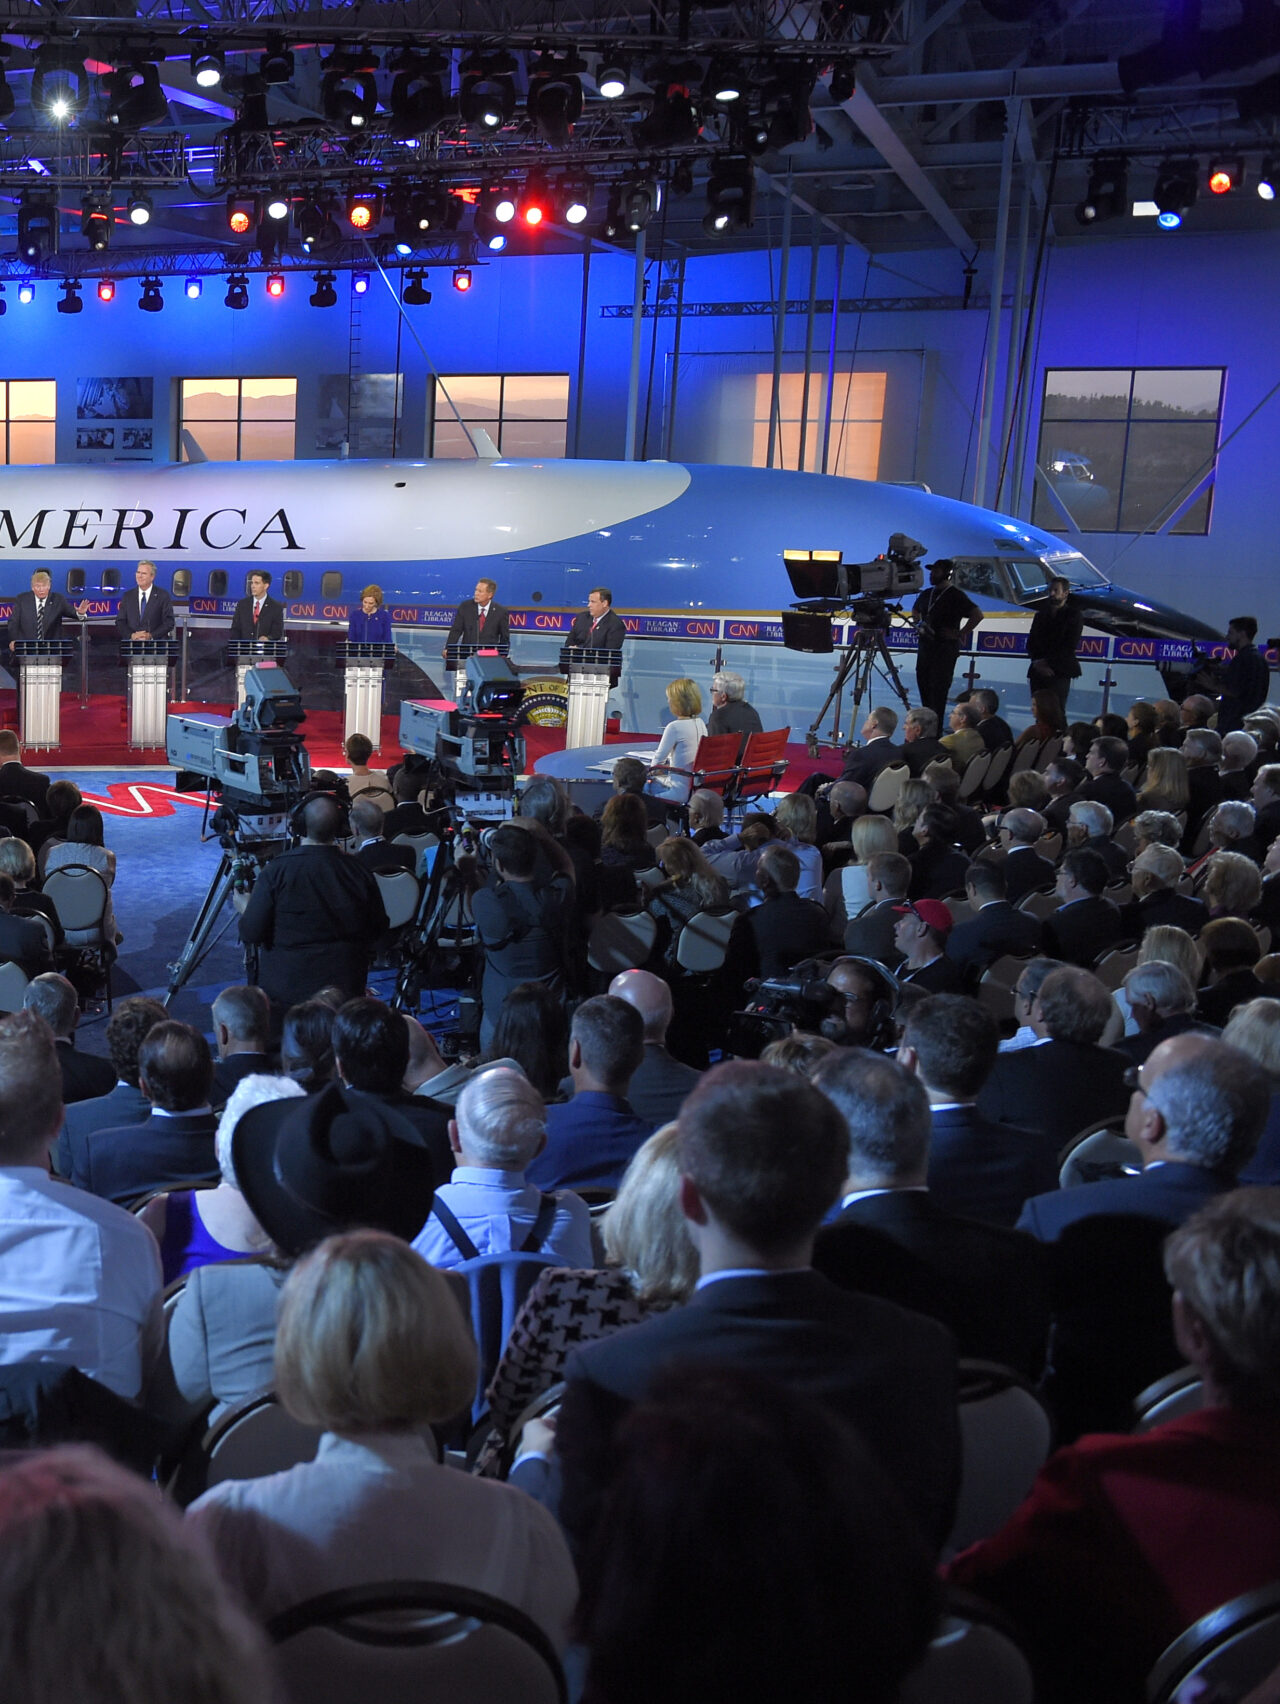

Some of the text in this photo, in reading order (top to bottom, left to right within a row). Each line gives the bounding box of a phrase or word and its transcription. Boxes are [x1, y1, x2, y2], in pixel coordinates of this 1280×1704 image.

[88, 600, 110, 613] CNN
[193, 600, 216, 611] CNN
[291, 604, 315, 617] CNN
[323, 605, 347, 618] CNN
[392, 609, 417, 621] CNN
[424, 610, 453, 618] REAGAN
[508, 613, 526, 626] NN
[535, 615, 562, 628] CNN
[622, 618, 639, 631] NN
[646, 620, 679, 628] REAGAN
[686, 622, 715, 635] CNN
[729, 623, 758, 637] CNN
[983, 635, 1015, 649] CNN
[1075, 640, 1103, 653] NN
[1121, 642, 1154, 656] CNN
